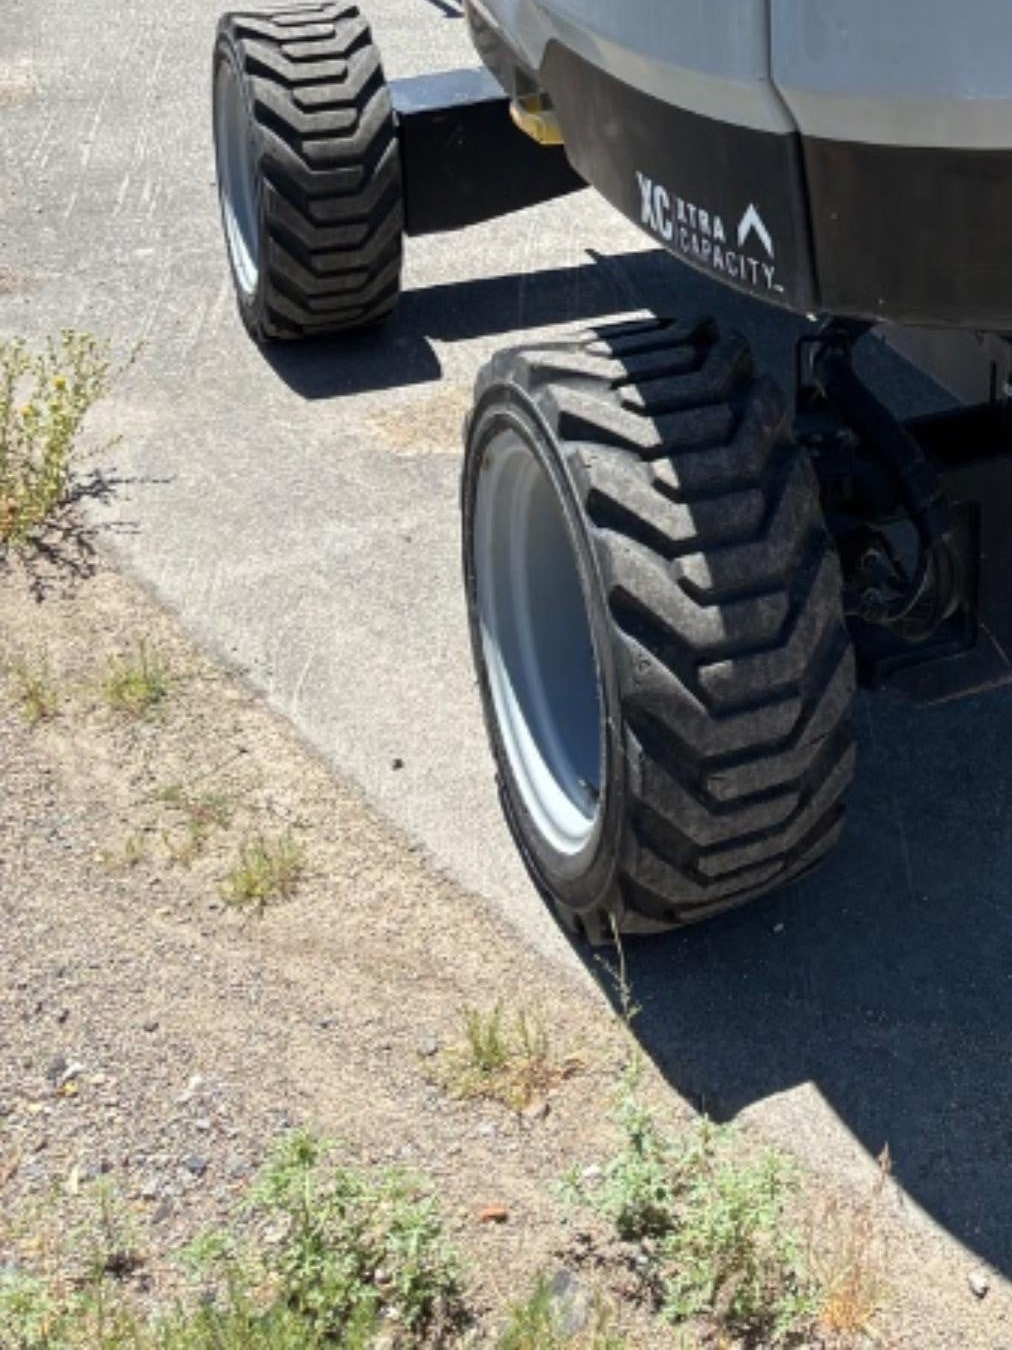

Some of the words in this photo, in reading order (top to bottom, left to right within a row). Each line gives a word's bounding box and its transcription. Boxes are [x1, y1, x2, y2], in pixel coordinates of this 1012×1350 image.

[635, 169, 673, 242] XC
[677, 197, 726, 245] XTRA
[680, 227, 776, 291] CAPACITY
